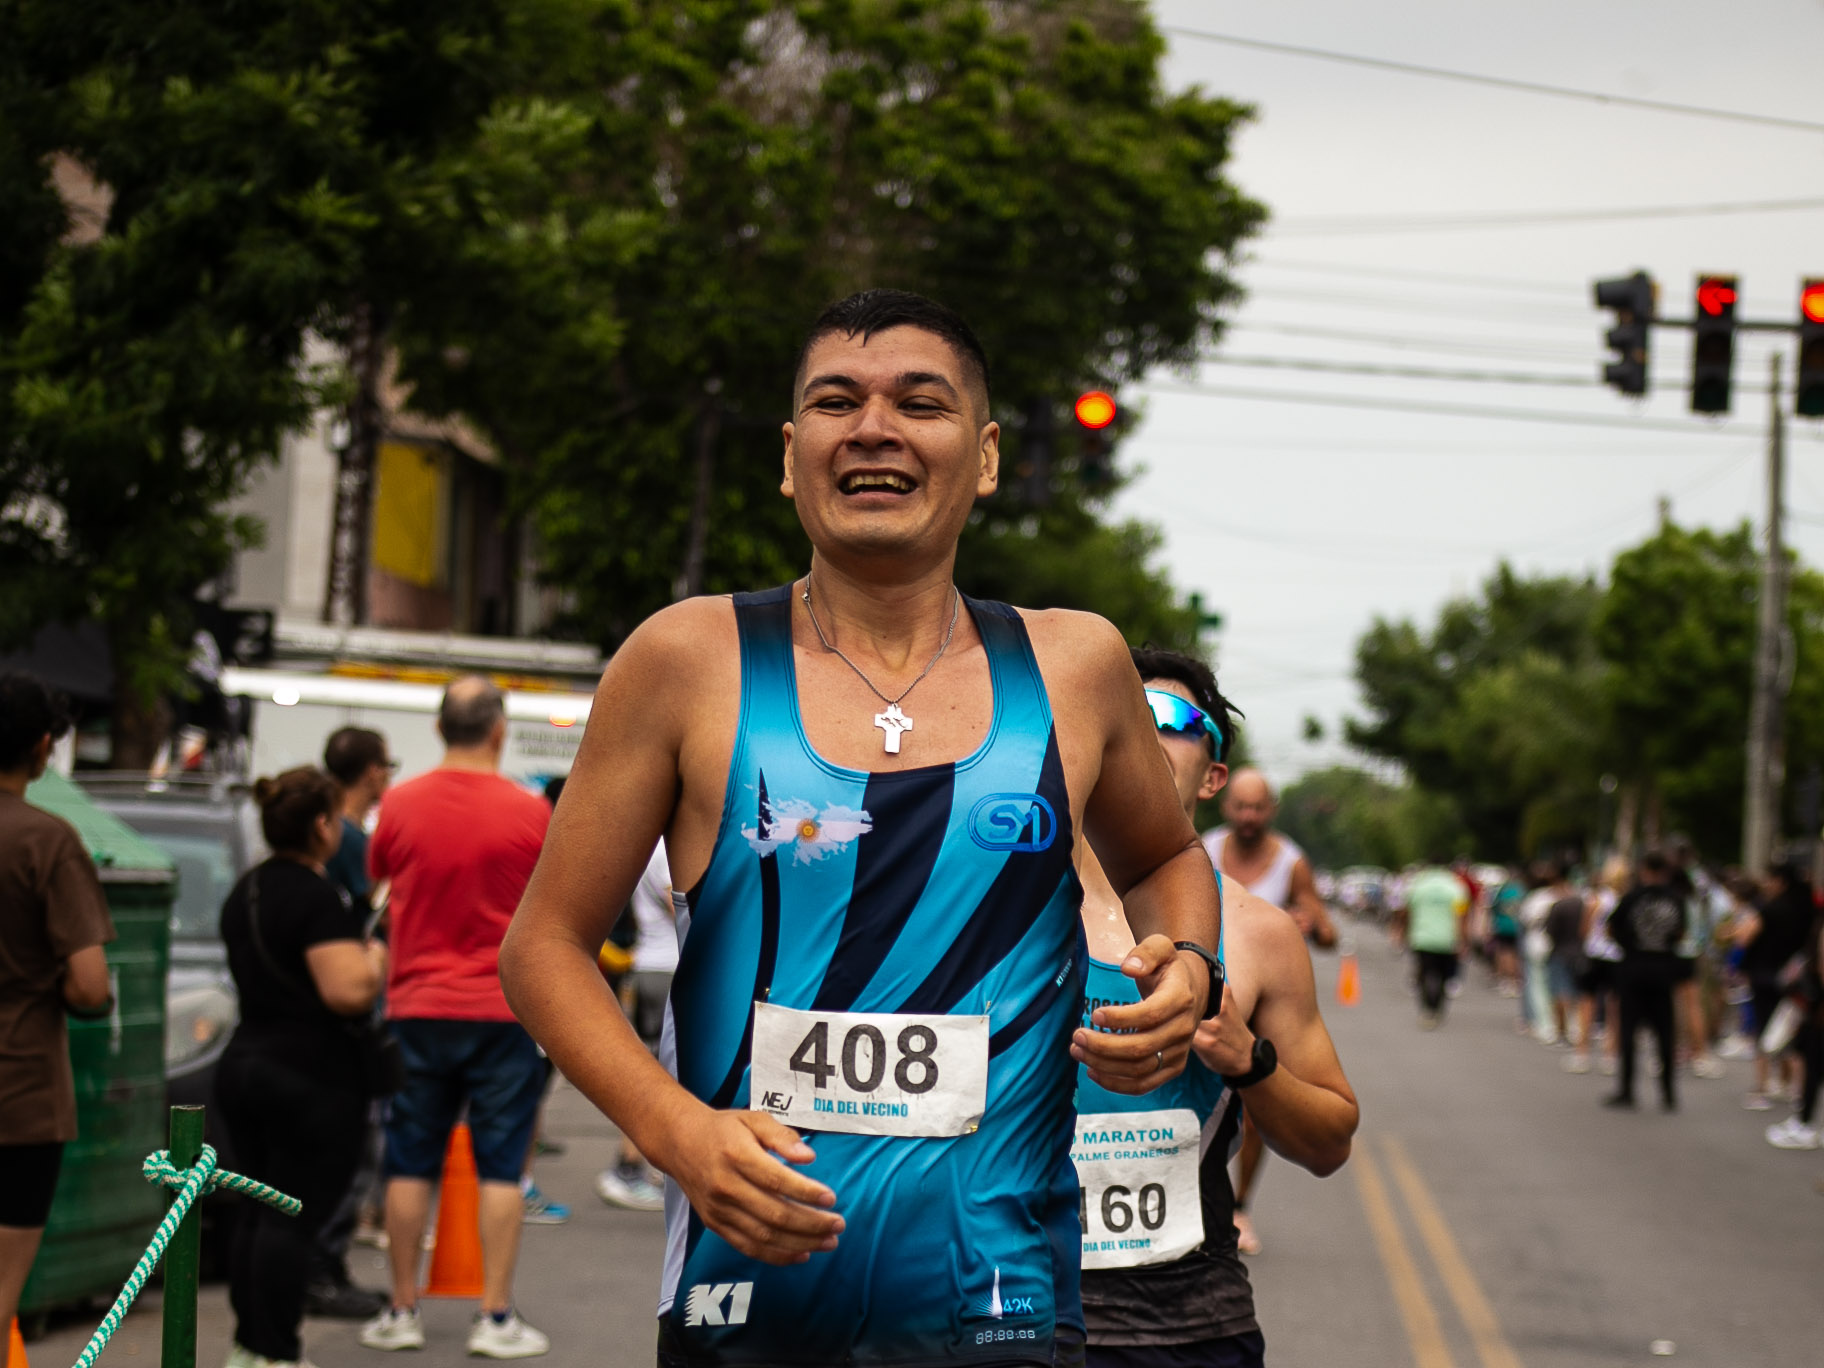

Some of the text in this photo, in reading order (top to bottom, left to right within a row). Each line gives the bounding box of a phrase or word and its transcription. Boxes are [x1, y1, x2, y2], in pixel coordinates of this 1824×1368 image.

[789, 1021, 939, 1094] 408
[761, 1091, 793, 1111] NEJ
[814, 1097, 908, 1118] DIA DEL VECINO
[1083, 1128, 1173, 1144] MARATON
[1114, 1146, 1179, 1160] GRANEROS
[1083, 1238, 1151, 1252] DIA DEL VECINO
[684, 1282, 754, 1327] K1
[1003, 1297, 1034, 1314] 42K
